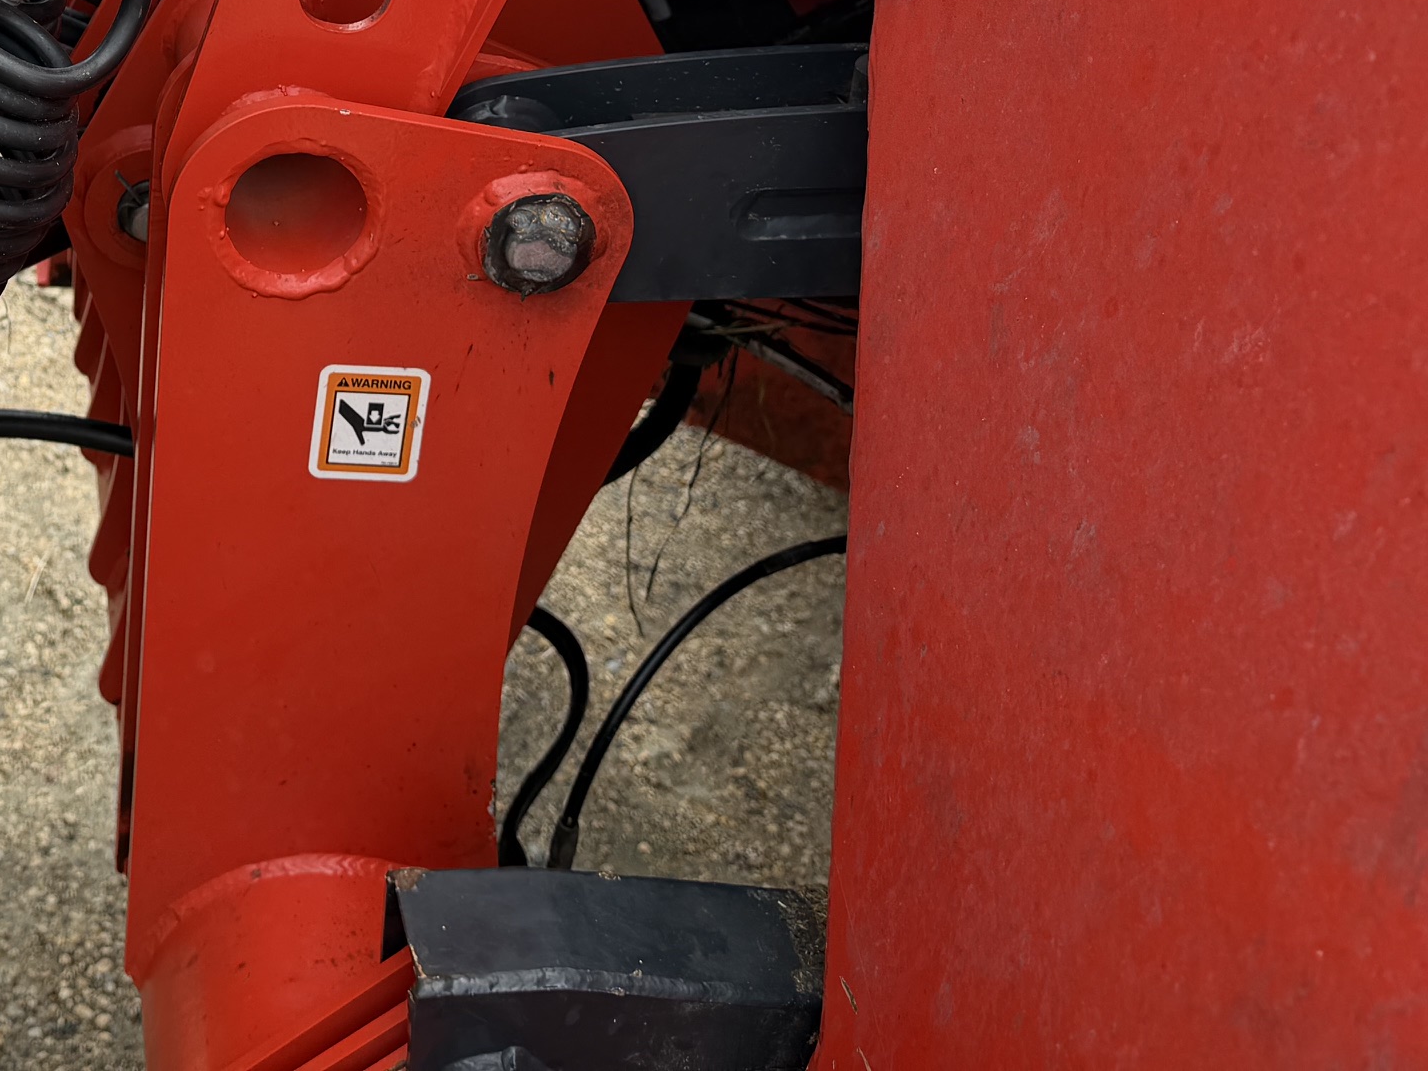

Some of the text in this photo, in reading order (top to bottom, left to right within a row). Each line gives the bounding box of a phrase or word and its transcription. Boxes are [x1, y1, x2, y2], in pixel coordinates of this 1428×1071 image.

[351, 377, 412, 390] WARNING
[332, 448, 351, 456] Keep
[377, 450, 397, 458] Away
